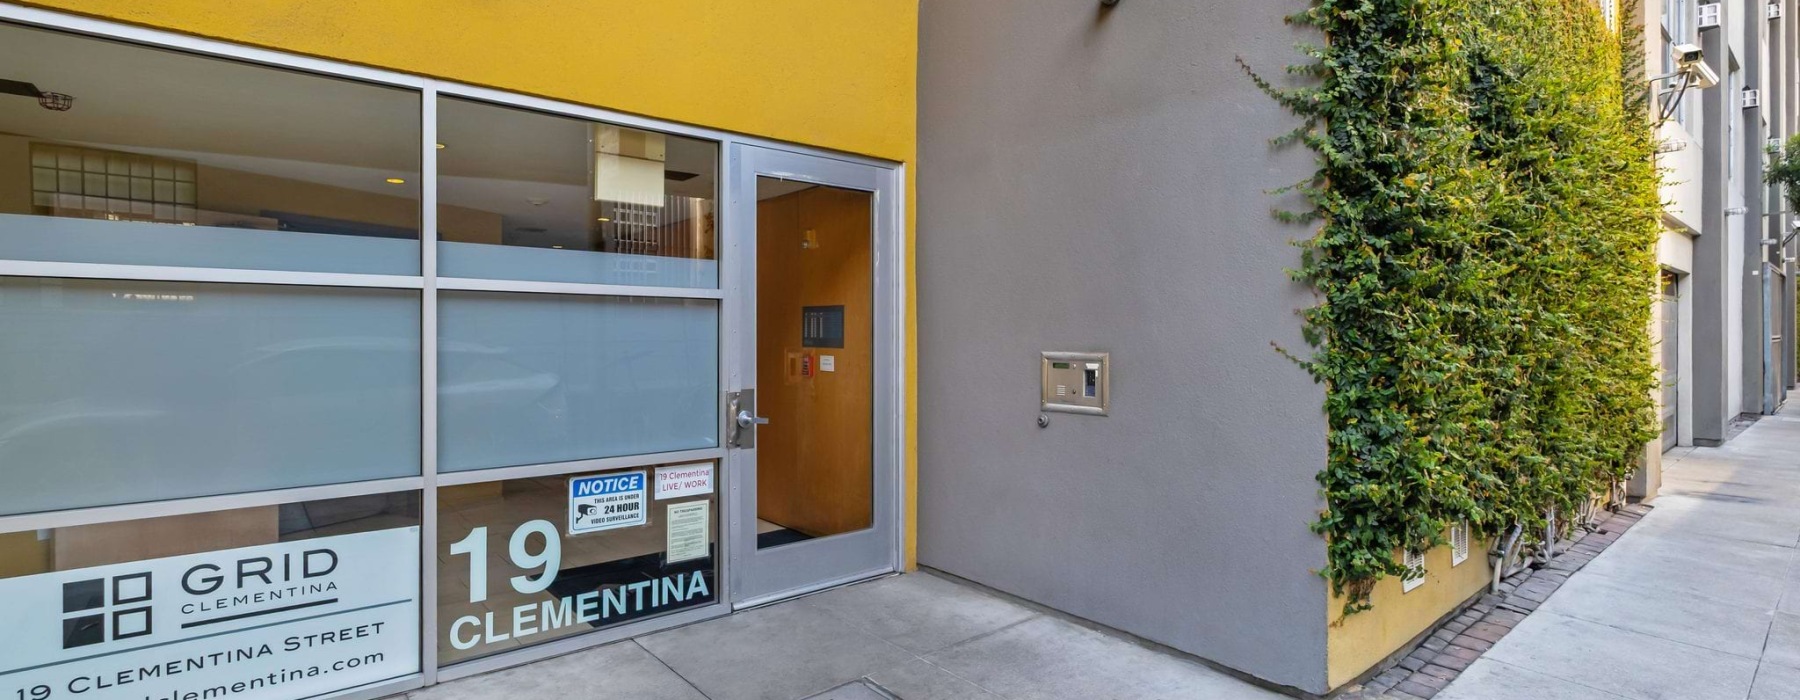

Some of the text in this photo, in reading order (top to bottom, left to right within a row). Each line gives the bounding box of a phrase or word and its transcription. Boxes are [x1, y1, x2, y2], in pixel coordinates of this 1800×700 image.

[660, 469, 710, 481] 19 Clementina
[684, 479, 707, 489] WORK
[578, 475, 639, 496] NOTICE
[625, 493, 640, 501] UNDER
[604, 502, 640, 515] 24 HOUR
[591, 513, 640, 525] VIDEO SURVEILLANCE
[450, 519, 561, 603] 19
[181, 548, 339, 595] GRID
[181, 581, 338, 615] CLEMENTINA
[449, 570, 709, 650] CLEMENTINA
[145, 652, 384, 700] lementina.com
[16, 684, 51, 700] 19
